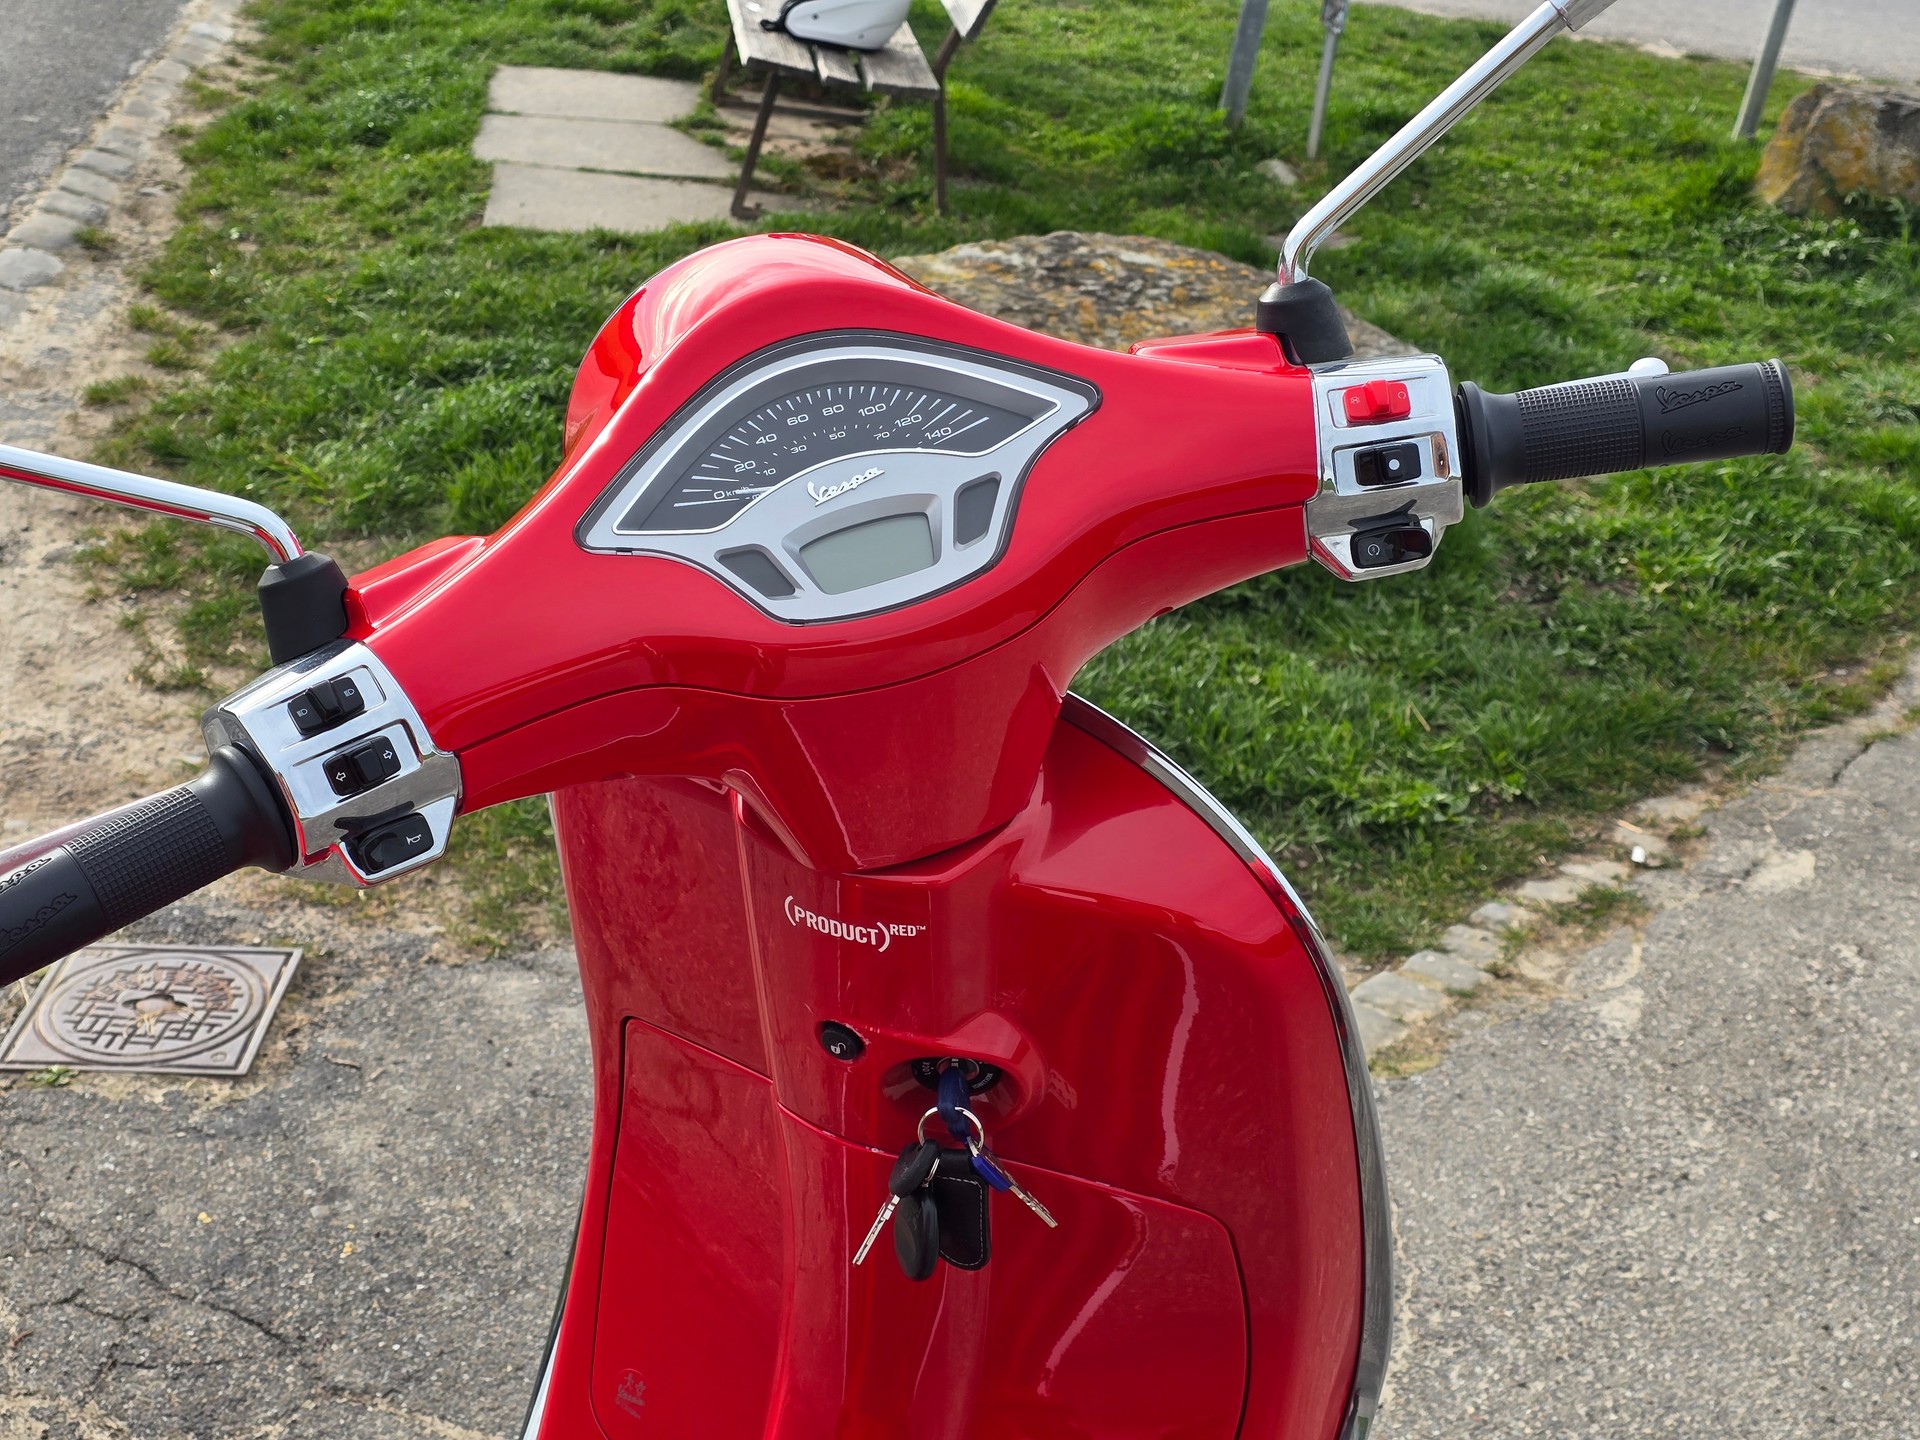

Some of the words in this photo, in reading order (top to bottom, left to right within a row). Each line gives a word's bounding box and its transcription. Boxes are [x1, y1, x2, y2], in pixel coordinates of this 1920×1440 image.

[1655, 381, 1743, 415] Vespa
[822, 404, 845, 416] 80
[858, 403, 886, 417] 100
[786, 414, 809, 426] 60
[894, 414, 923, 428] 120
[755, 433, 778, 445] 40
[829, 431, 846, 441] 50
[873, 431, 890, 441] 70
[924, 427, 952, 440] 140
[1661, 426, 1749, 458] Vespa
[790, 444, 807, 454] 30
[734, 460, 756, 473] 20
[763, 468, 777, 476] 10
[807, 467, 885, 507] Vespa
[713, 490, 725, 500] 0
[784, 895, 891, 953] (PRODUCT)
